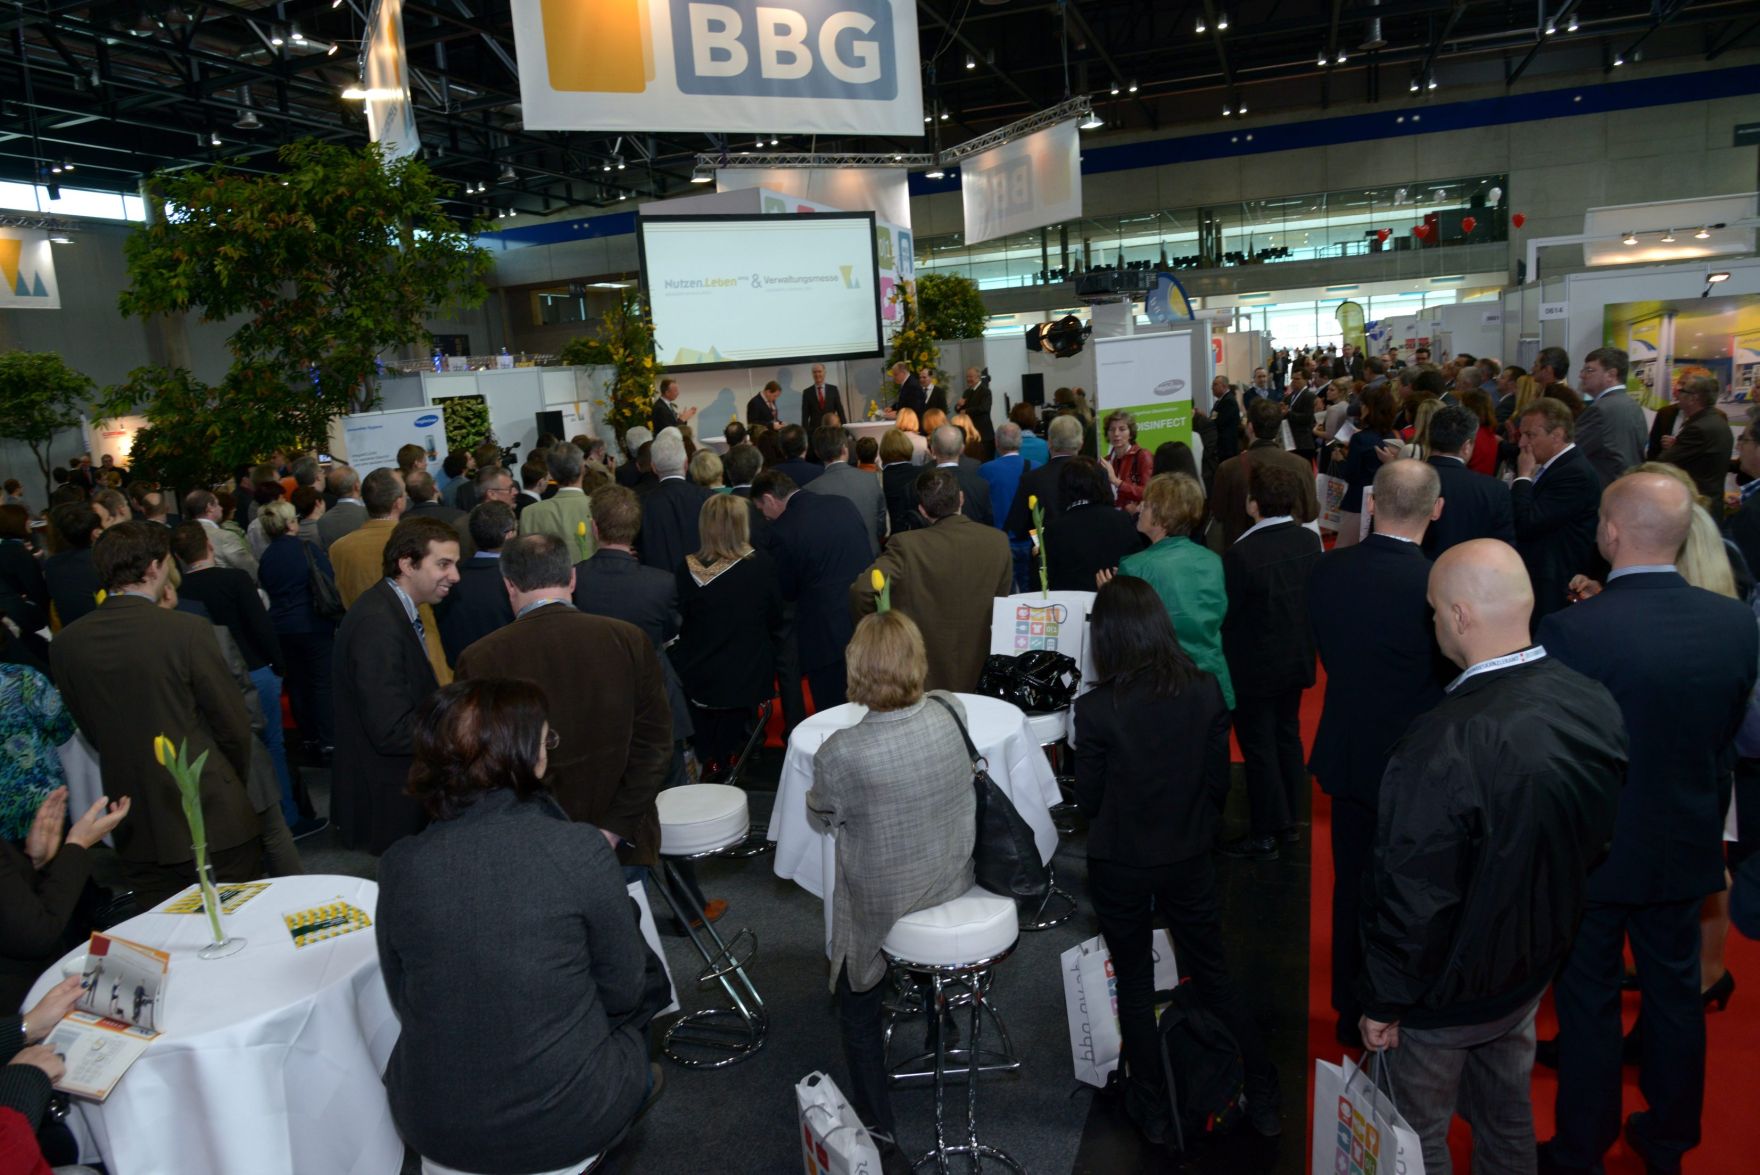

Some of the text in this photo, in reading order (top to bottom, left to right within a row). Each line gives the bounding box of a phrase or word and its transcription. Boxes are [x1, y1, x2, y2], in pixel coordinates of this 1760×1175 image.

[688, 2, 882, 84] BBG
[751, 274, 763, 289] &
[763, 274, 839, 285] Verwaltungsmesse
